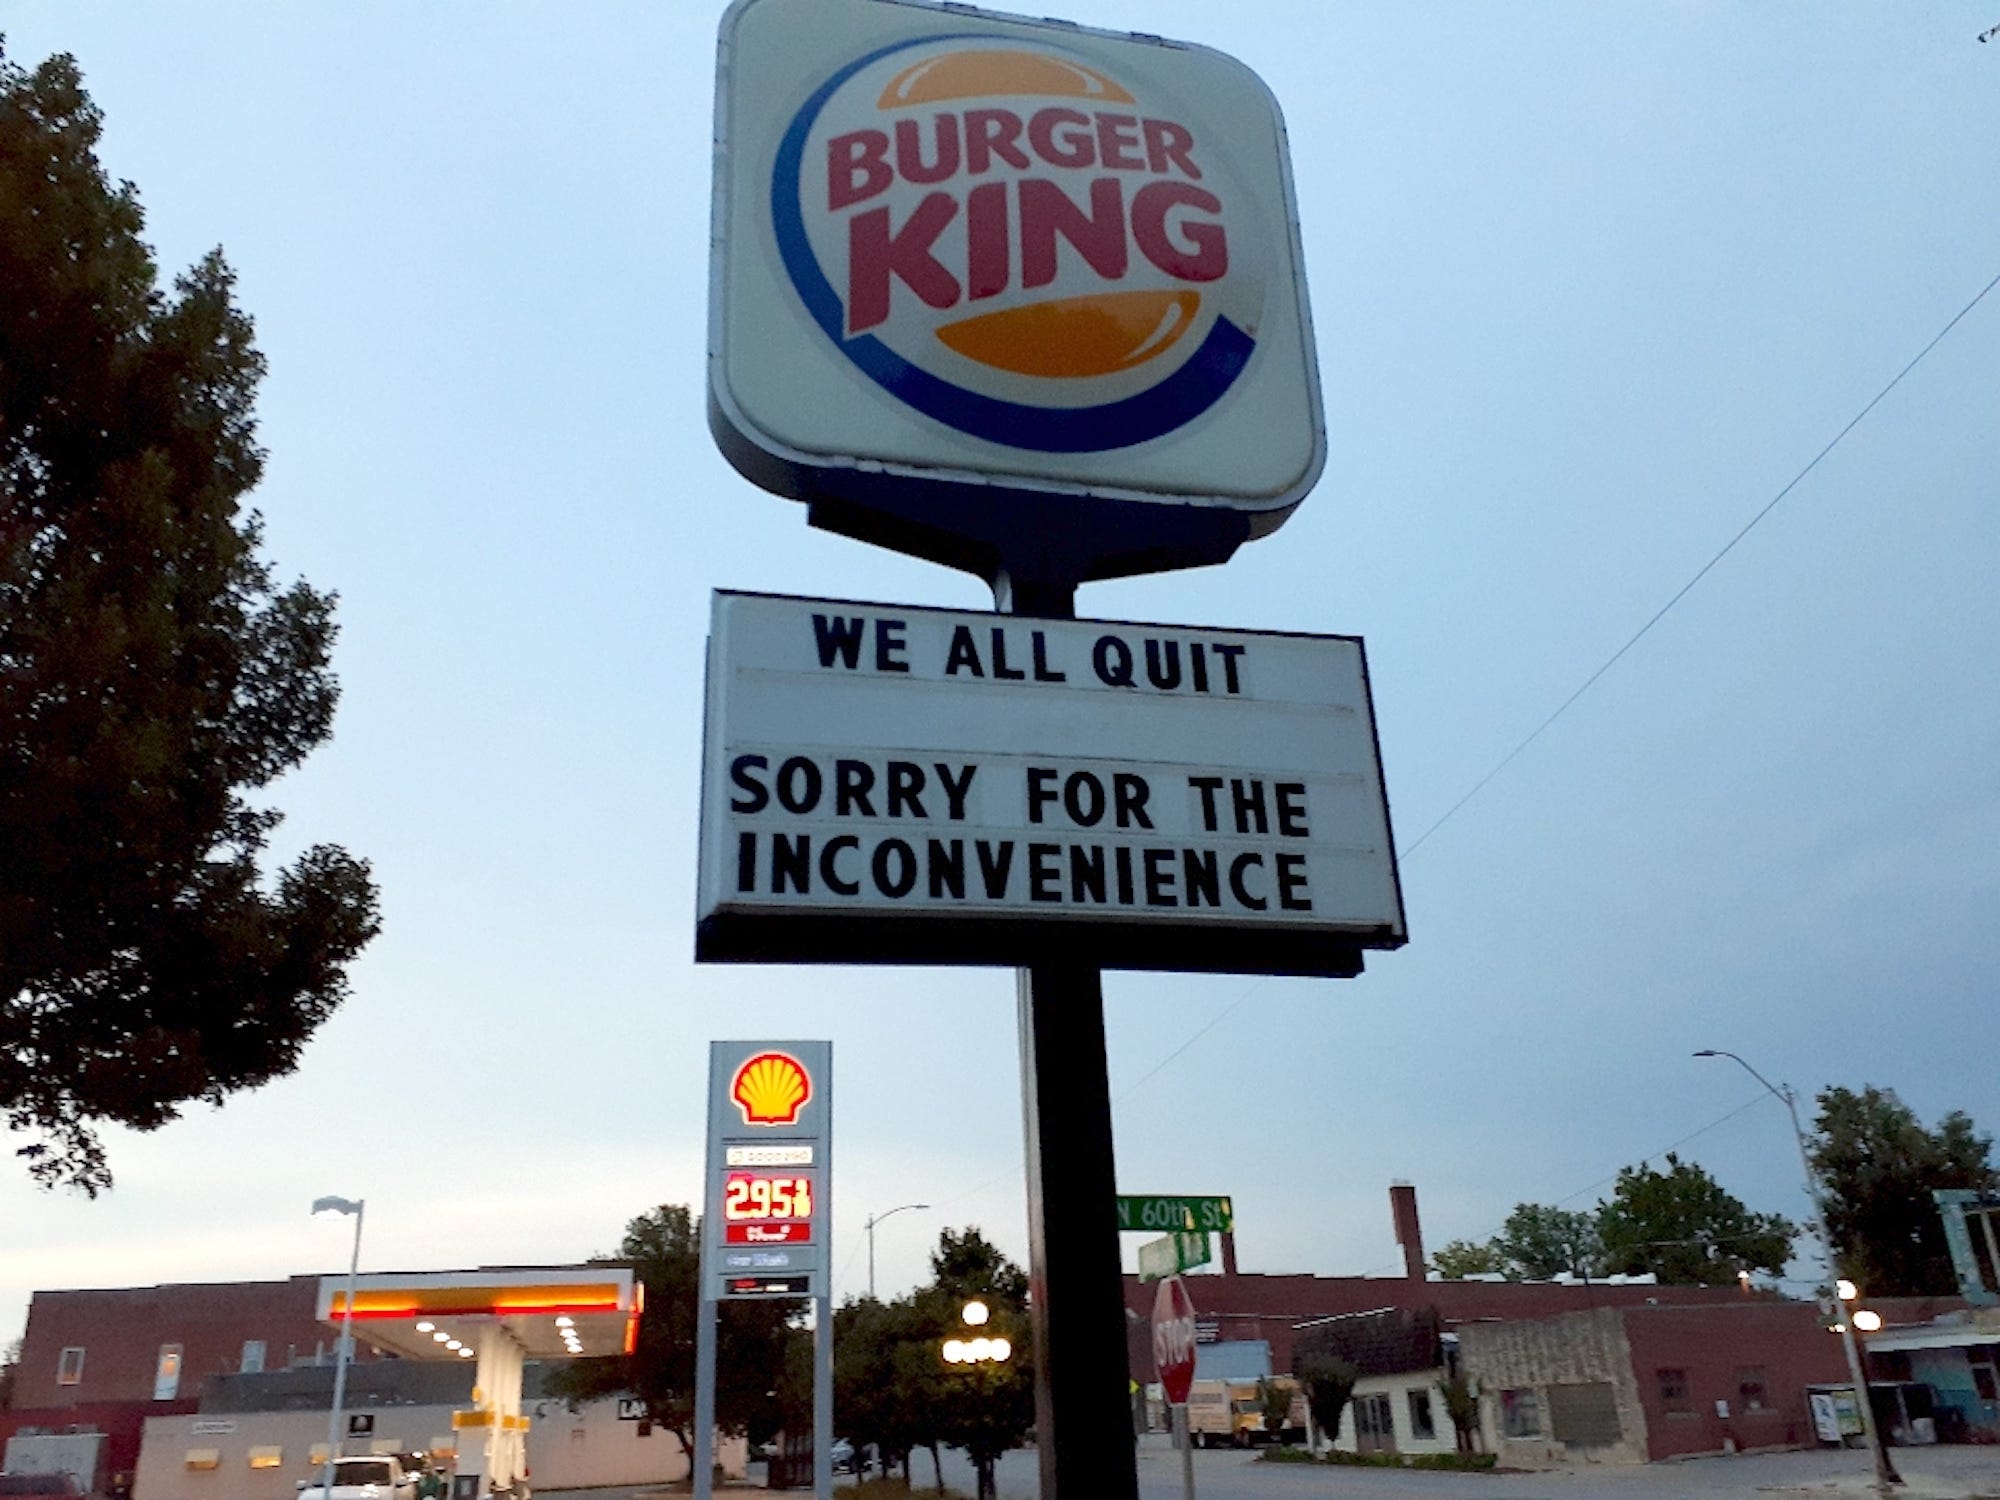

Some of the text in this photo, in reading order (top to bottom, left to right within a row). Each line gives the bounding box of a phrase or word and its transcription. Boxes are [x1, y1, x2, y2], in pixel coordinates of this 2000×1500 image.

[828, 107, 1203, 212] BURGER
[848, 177, 1229, 335] KING
[811, 613, 1246, 695] WE ALL QUIT
[729, 754, 1311, 838] SORRY FOR THE
[736, 832, 1313, 911] INCONVENIENCE
[1116, 1199, 1223, 1228] N 60th St
[1155, 1317, 1193, 1367] STOP
